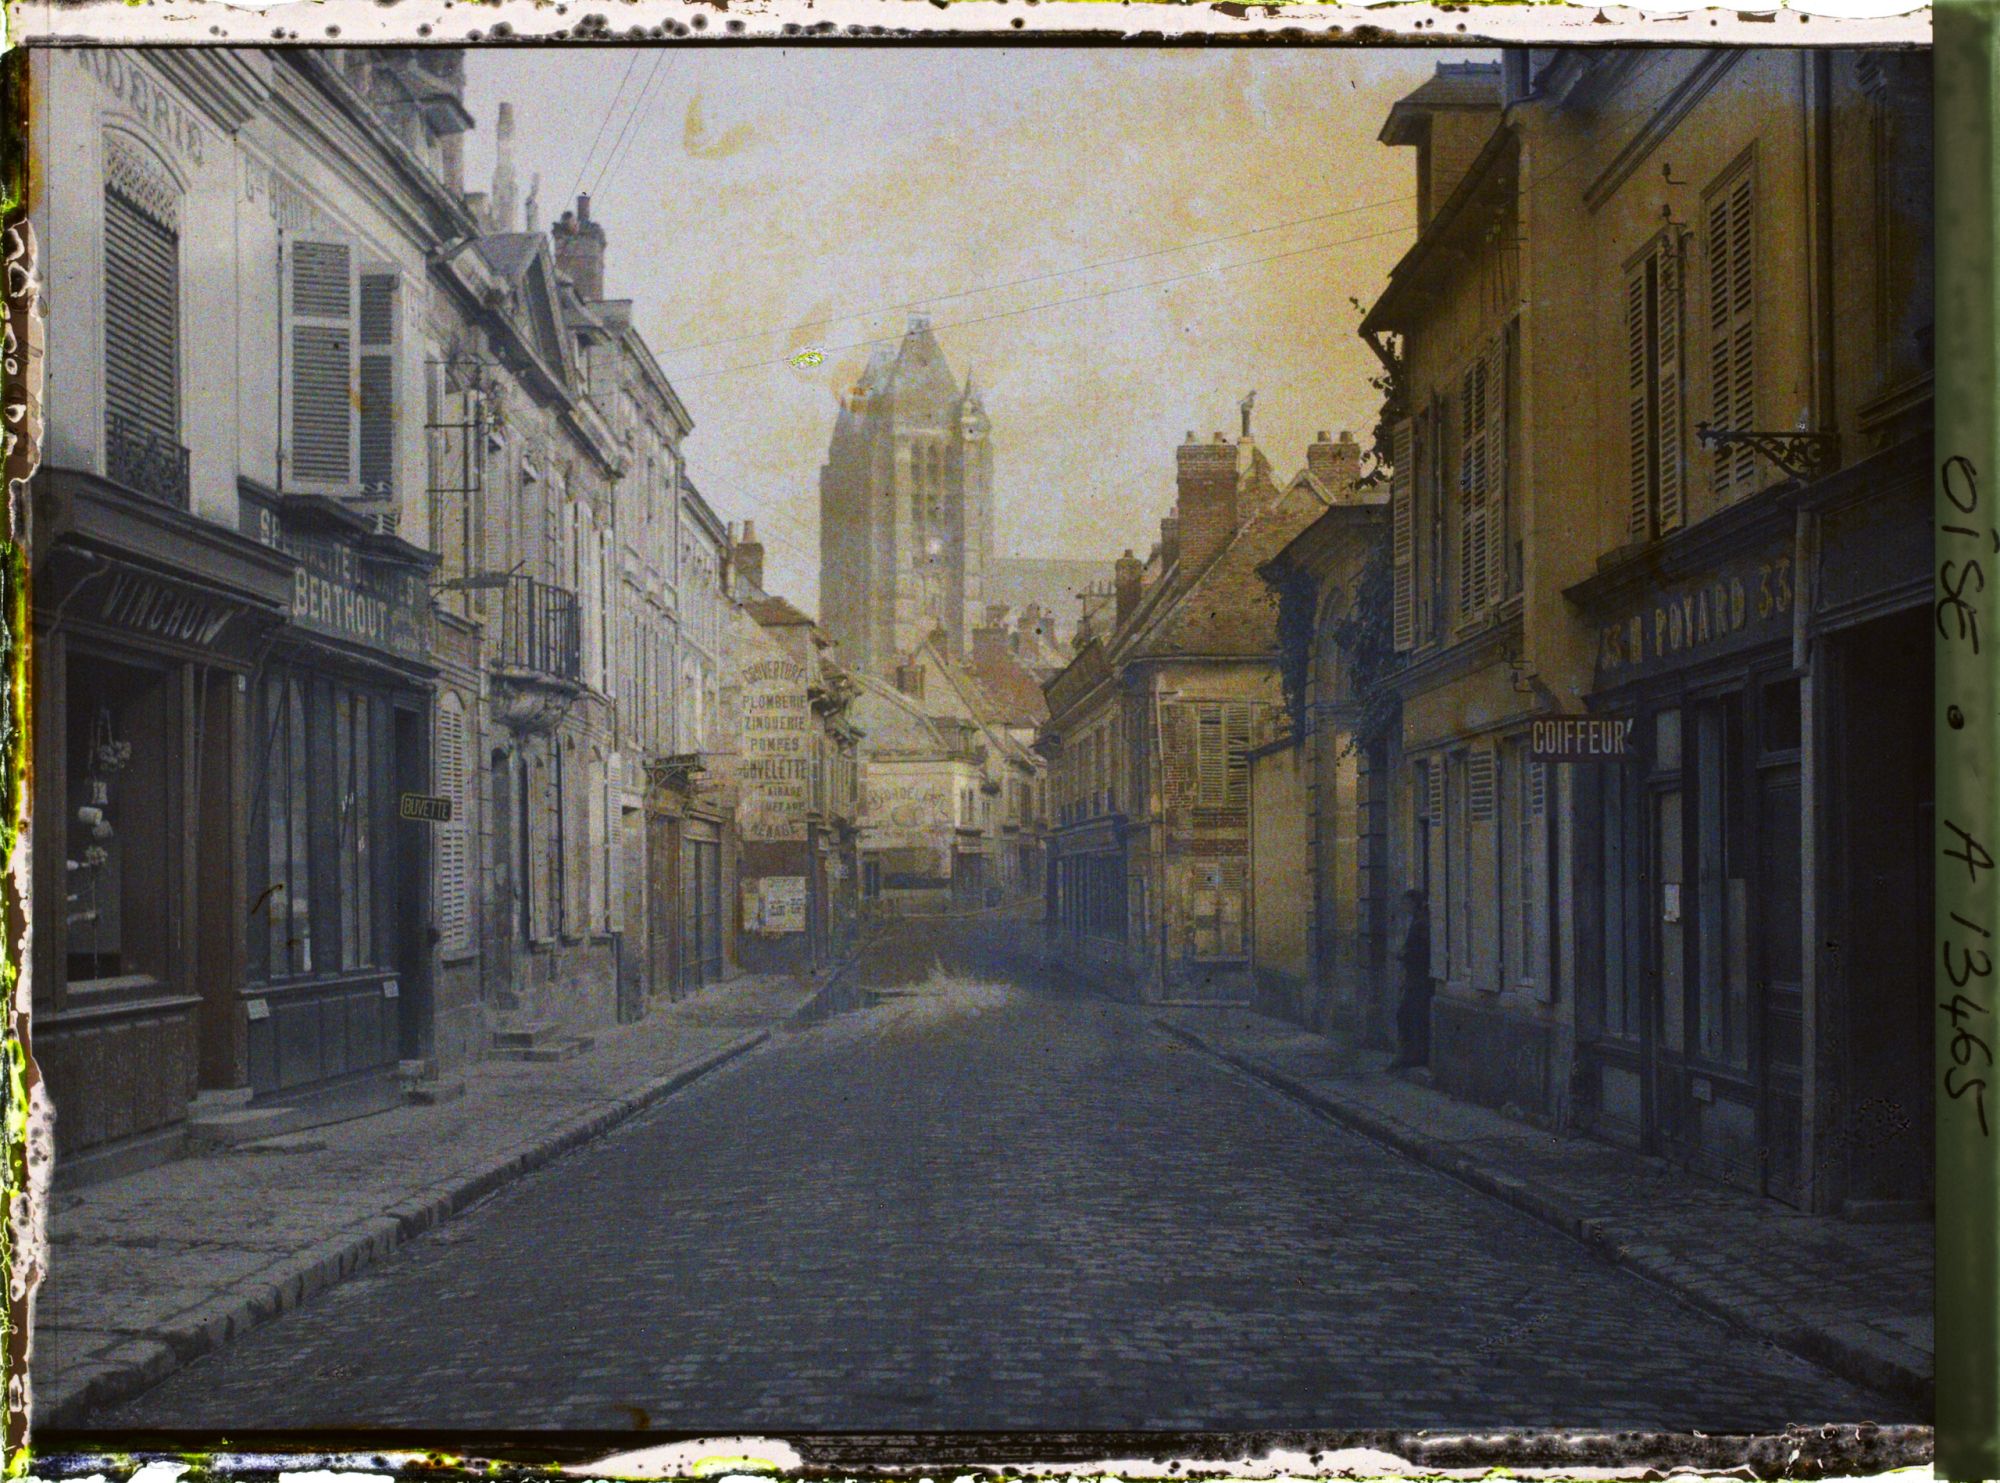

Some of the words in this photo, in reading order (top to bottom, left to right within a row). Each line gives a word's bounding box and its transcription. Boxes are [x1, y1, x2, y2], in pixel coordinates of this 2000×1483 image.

[293, 566, 388, 642] BERTHOUT
[1655, 576, 1746, 657] POYARD
[743, 694, 806, 710] PLOMBERIE
[750, 738, 800, 752] POMPES
[403, 798, 450, 820] BUVETTE
[1943, 818, 1994, 885] A
[1939, 913, 1989, 1138] 13465
